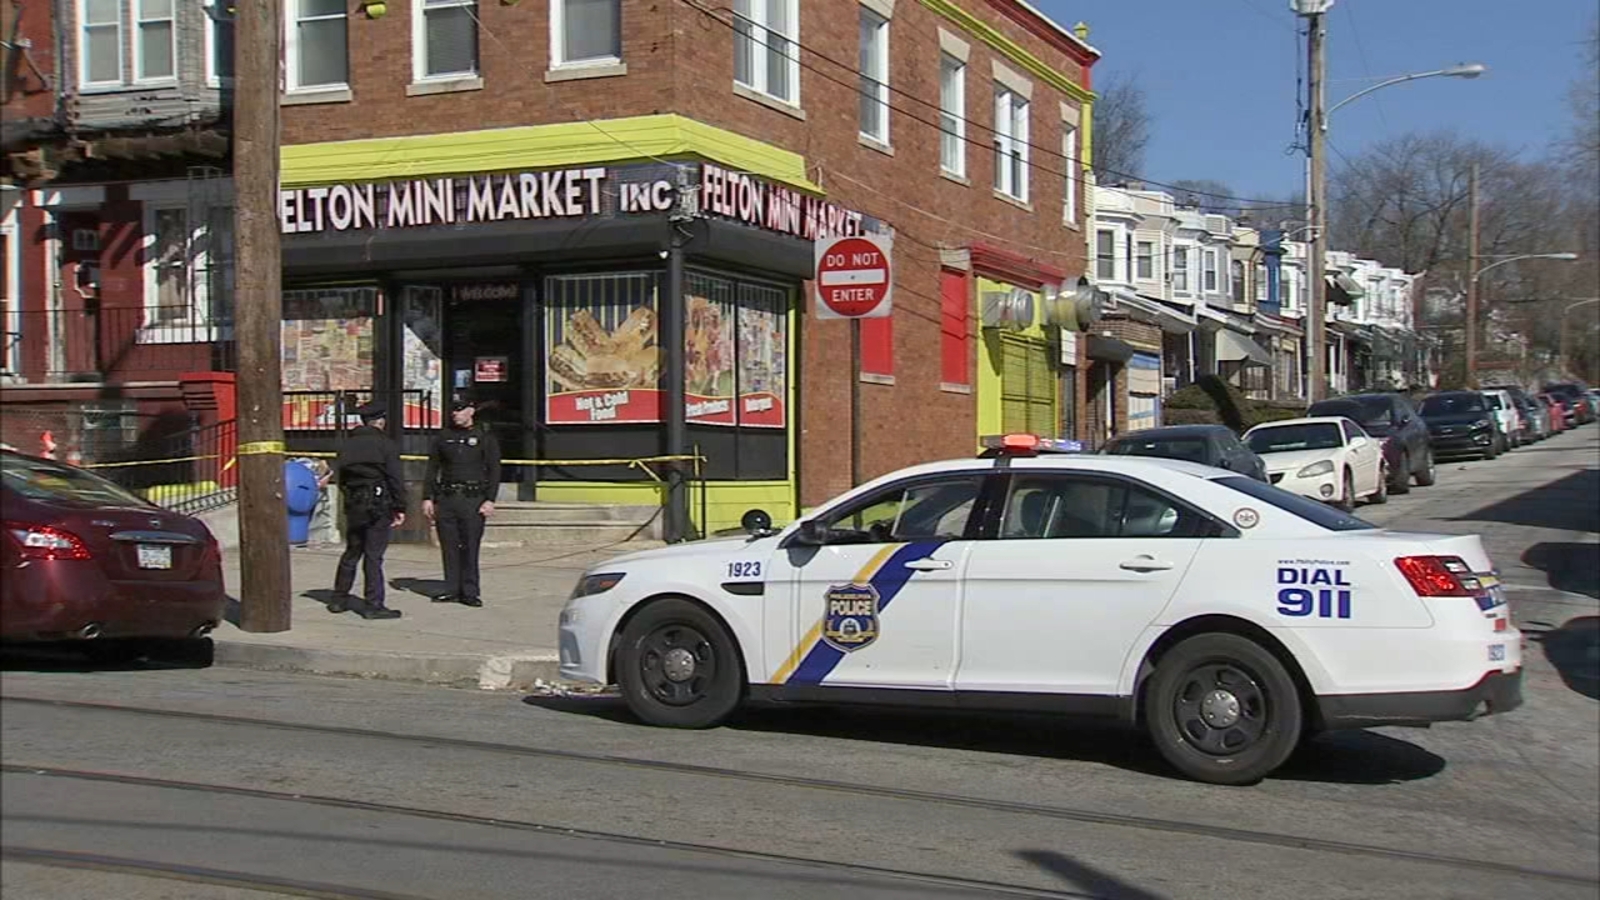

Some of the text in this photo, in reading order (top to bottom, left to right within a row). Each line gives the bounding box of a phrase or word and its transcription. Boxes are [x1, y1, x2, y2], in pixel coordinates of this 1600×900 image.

[279, 167, 673, 234] ELTON MINI MARKET INC
[702, 163, 862, 242] FELTON MINI MARKET
[827, 252, 878, 267] DO NOT
[832, 289, 874, 302] ENTER
[728, 562, 761, 577] 1923
[1277, 568, 1351, 586] DIAL
[830, 599, 872, 616] POLICE
[1277, 588, 1351, 619] 911
